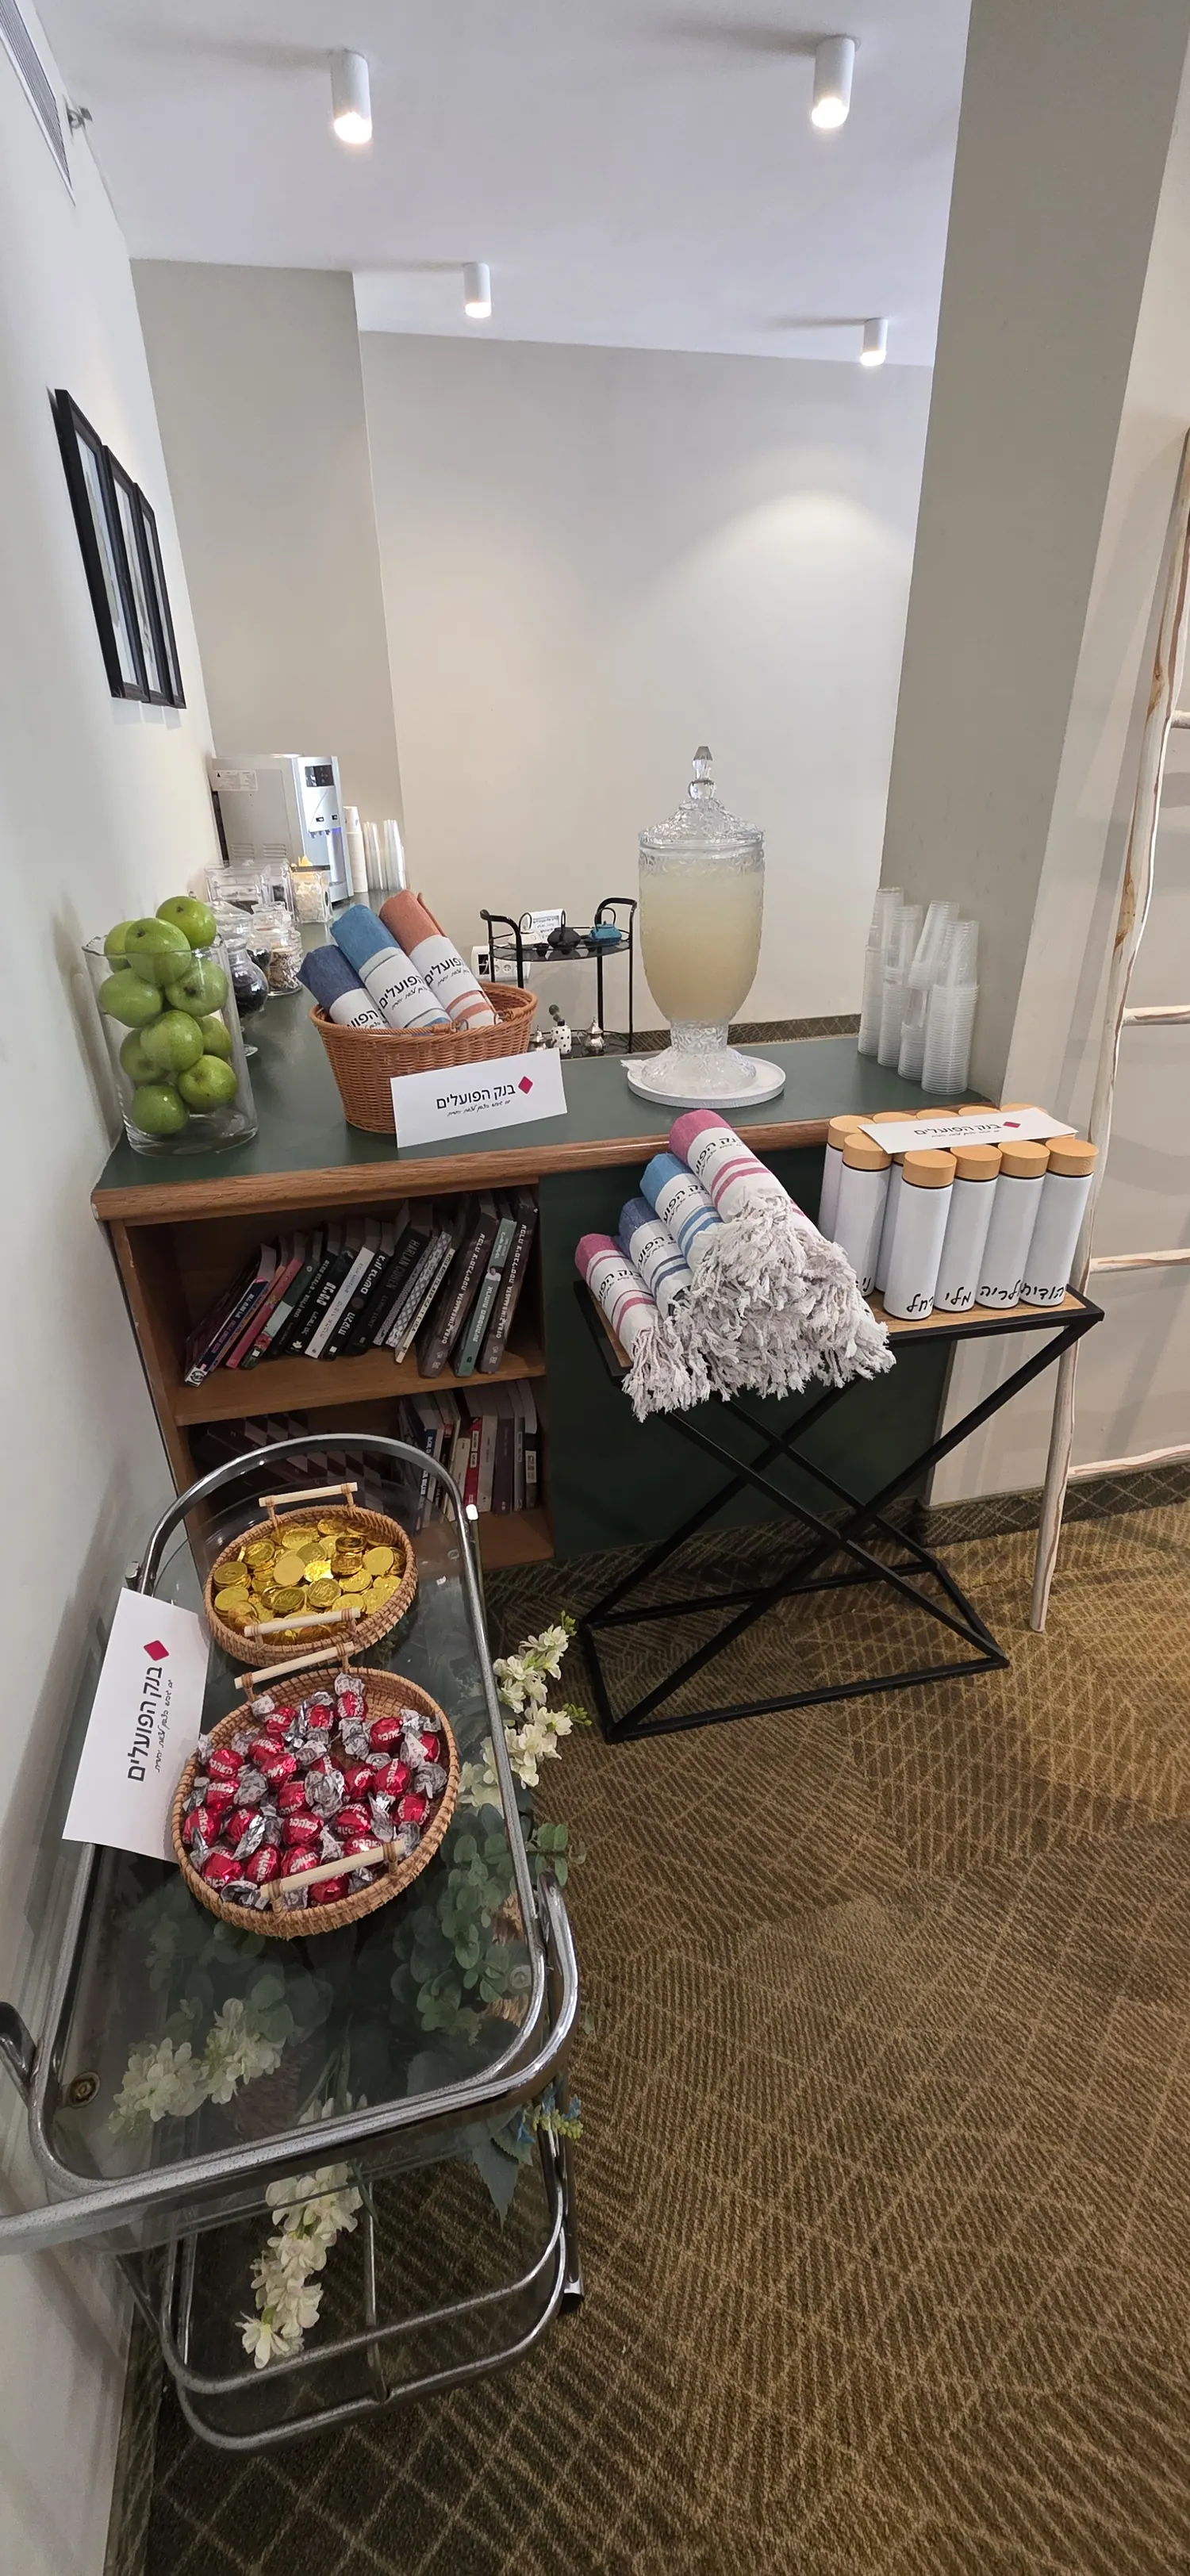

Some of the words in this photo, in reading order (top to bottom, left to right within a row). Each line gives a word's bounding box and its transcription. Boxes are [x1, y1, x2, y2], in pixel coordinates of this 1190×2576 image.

[436, 1088, 491, 1110] הפועלים
[493, 1084, 516, 1100] בנק
[913, 1125, 977, 1135] הפועלים
[976, 1124, 1002, 1134] בנק
[474, 1233, 486, 1253] עפרה
[518, 1224, 527, 1244] עפרה
[398, 1239, 420, 1267] HARLAN
[360, 1269, 379, 1294] גרישם
[944, 1286, 972, 1307] מלי
[441, 1328, 451, 1345] OFRA
[143, 1666, 163, 1698] בנק
[127, 1700, 157, 1783] הפועלים
